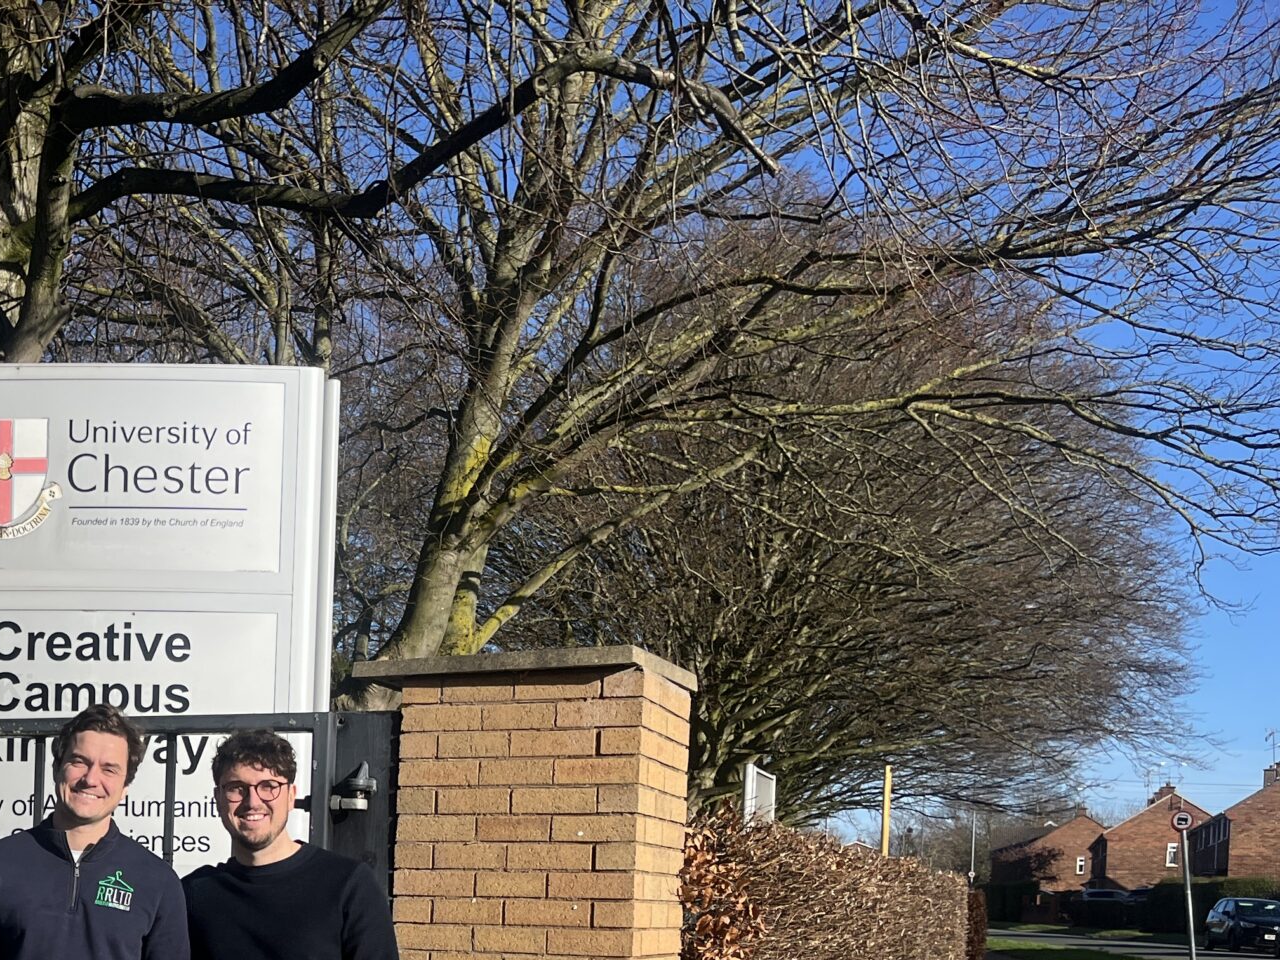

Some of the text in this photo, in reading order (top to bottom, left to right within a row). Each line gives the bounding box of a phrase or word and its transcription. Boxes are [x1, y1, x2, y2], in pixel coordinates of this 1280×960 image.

[69, 419, 252, 450] University of
[67, 453, 250, 494] Chester
[71, 517, 244, 529] Founded in 1839 by the Church of England
[12, 793, 35, 816] of
[111, 794, 222, 818] Humanit
